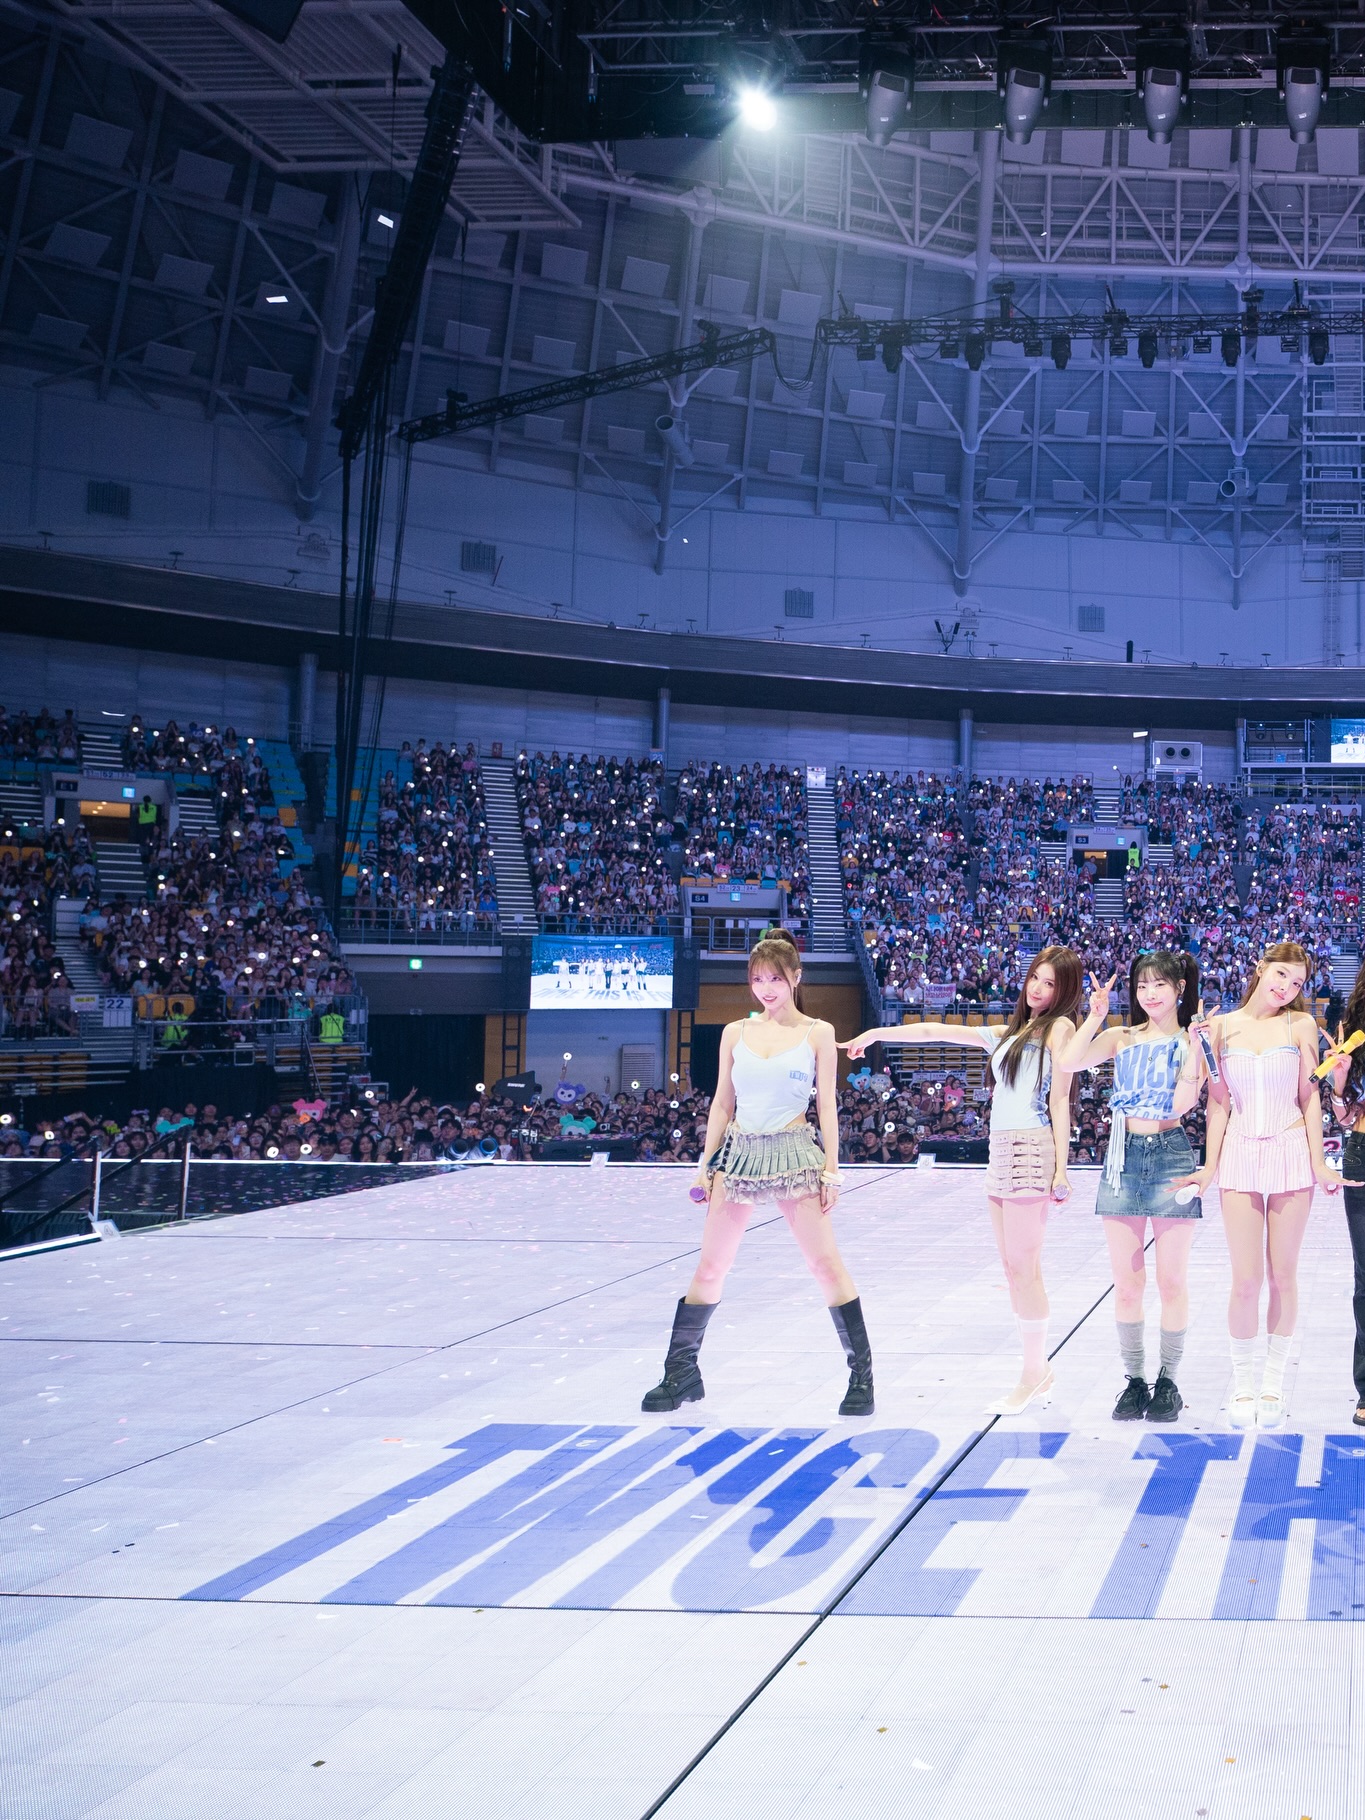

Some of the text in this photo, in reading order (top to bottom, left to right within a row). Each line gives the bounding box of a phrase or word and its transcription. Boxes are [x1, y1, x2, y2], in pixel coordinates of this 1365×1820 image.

[584, 989, 620, 1000] THIS
[107, 999, 124, 1009] 22
[178, 1423, 1070, 1617] TWICE
